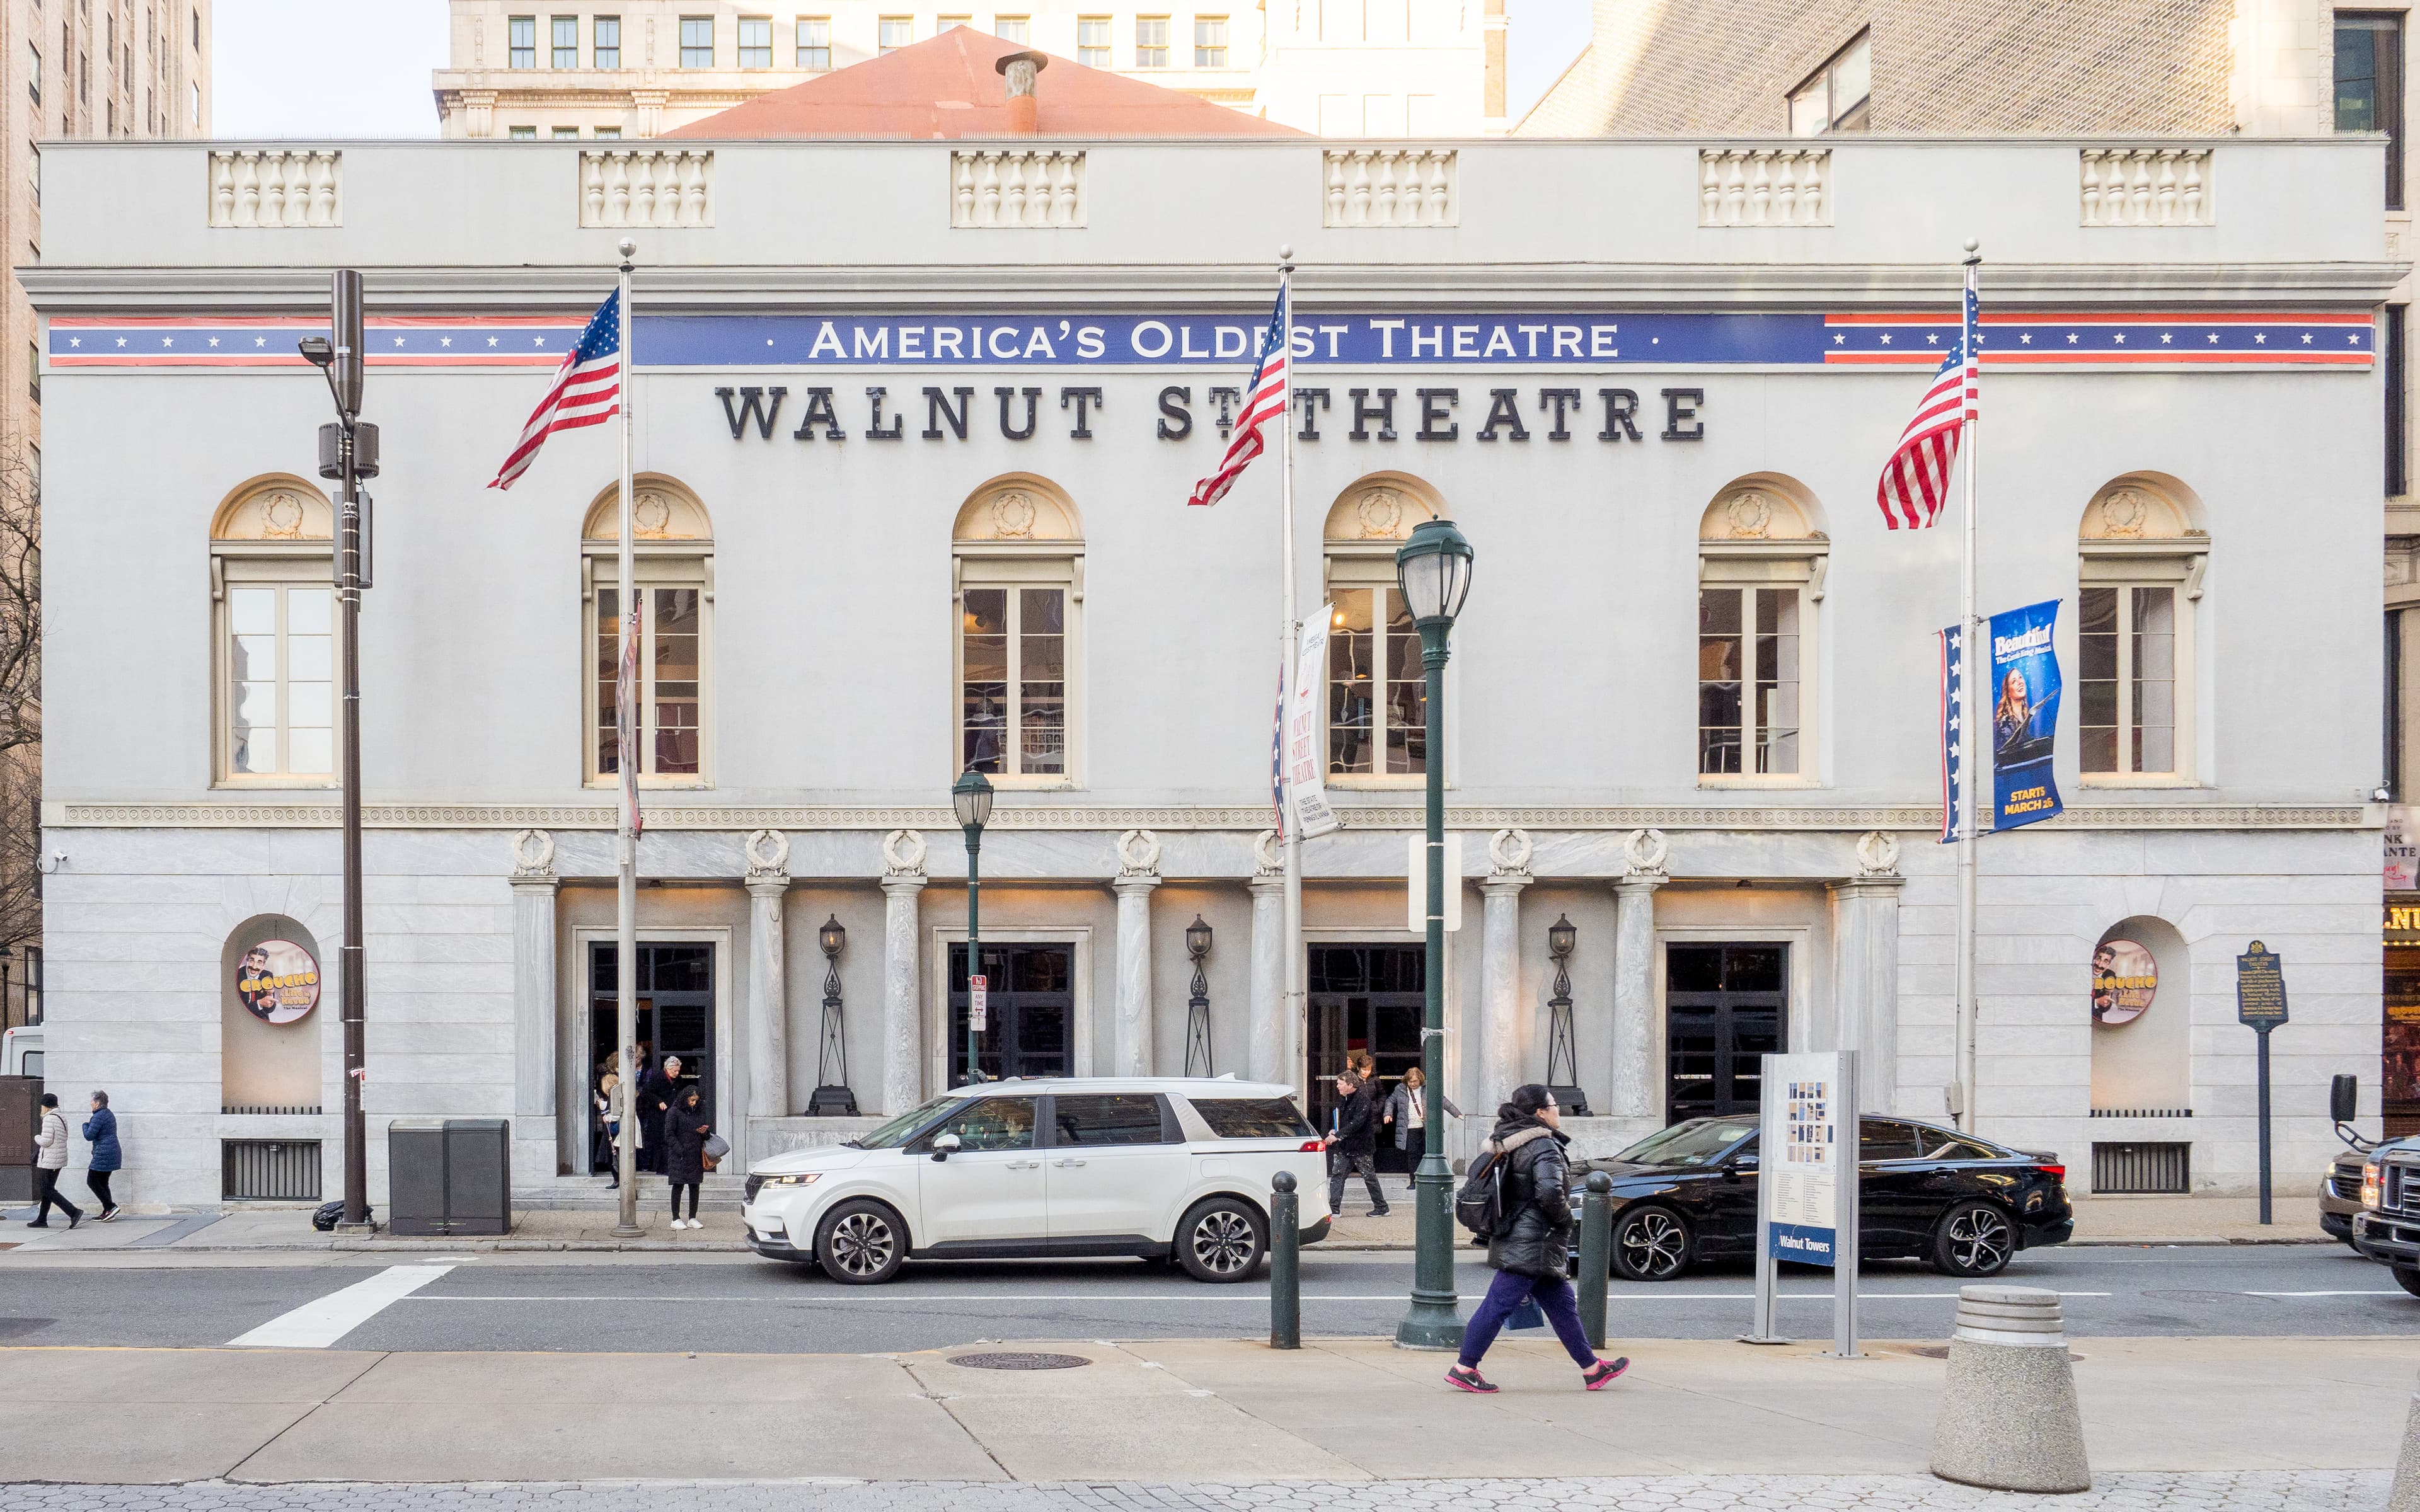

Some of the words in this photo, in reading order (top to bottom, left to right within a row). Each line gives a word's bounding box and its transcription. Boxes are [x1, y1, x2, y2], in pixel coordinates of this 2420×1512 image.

[809, 320, 1106, 360] AMERICA'S
[1369, 318, 1618, 358] THEATRE
[715, 386, 1102, 440] WALNUT
[1292, 387, 1704, 441] THEATRE
[1995, 623, 2052, 656] Beautiful
[2010, 786, 2045, 802] STARTS
[2005, 799, 2042, 815] MARCH
[2043, 797, 2054, 809] 26
[239, 971, 318, 993] GROUCHO
[1780, 1235, 1804, 1250] Walnut
[1805, 1237, 1830, 1253] Towers
